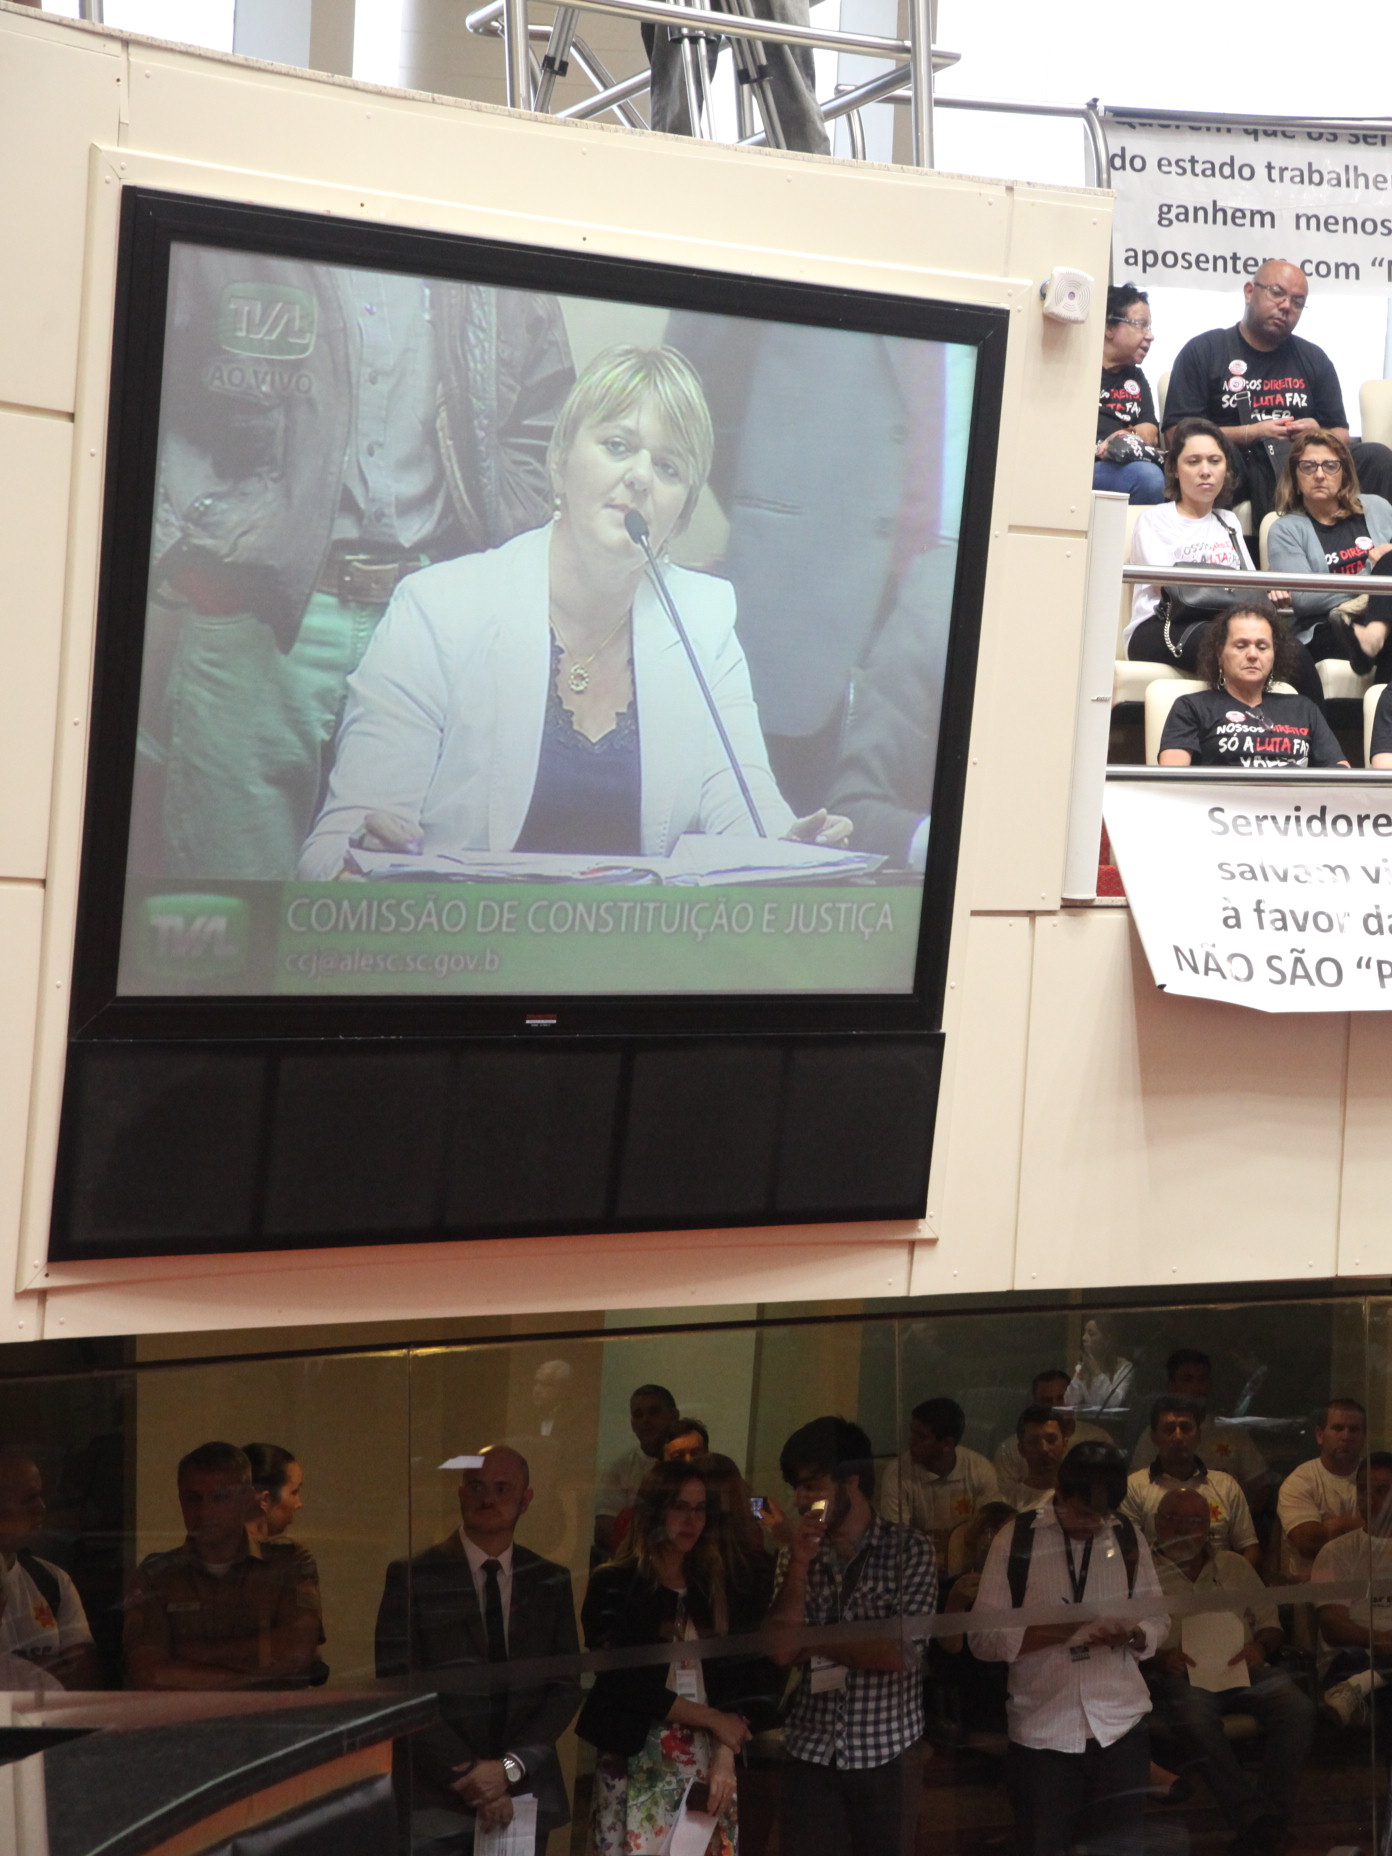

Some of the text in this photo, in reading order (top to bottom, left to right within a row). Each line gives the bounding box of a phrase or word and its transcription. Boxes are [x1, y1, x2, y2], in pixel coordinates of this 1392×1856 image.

[1109, 146, 1147, 172] do
[1157, 155, 1256, 181] estado
[1157, 200, 1276, 229] ganhem
[1295, 212, 1392, 237] menos
[1300, 258, 1361, 281] com
[210, 365, 313, 394] AO VIVO
[1263, 378, 1306, 391] DIREITOS
[1253, 394, 1285, 408] LUTA
[1285, 392, 1308, 408] FAZ
[1216, 722, 1265, 735] NOSSOS
[1219, 733, 1239, 753] SÓ
[1243, 736, 1254, 753] A
[1256, 737, 1291, 754] LUTA
[287, 895, 894, 942] COMISSÃO DE CONSTITUIÇÃO E JUSTIÇA
[1221, 897, 1242, 930] à
[1253, 899, 1350, 934] favor
[1172, 943, 1254, 982] NÃO
[1266, 948, 1344, 987] SÃO
